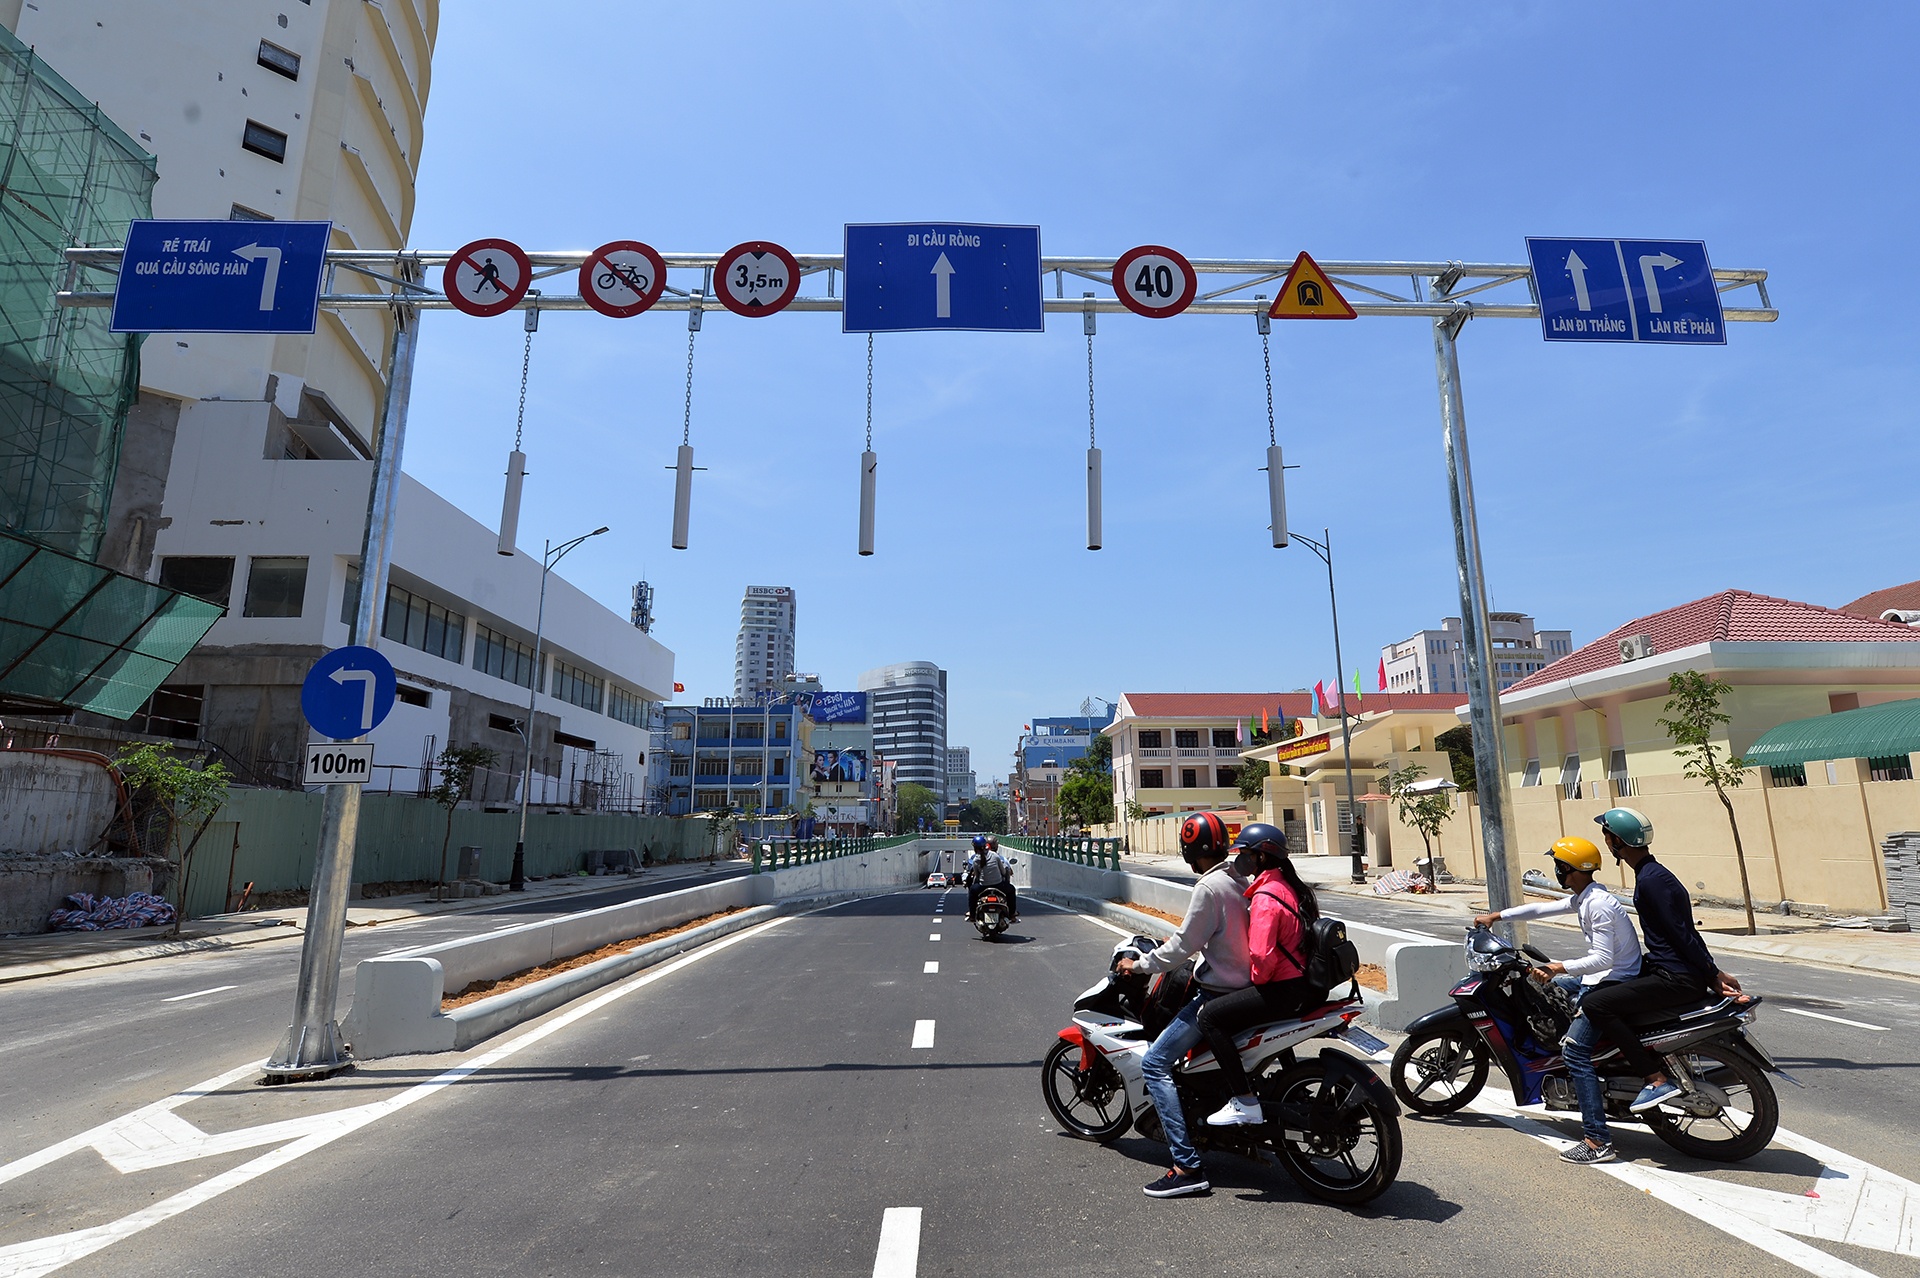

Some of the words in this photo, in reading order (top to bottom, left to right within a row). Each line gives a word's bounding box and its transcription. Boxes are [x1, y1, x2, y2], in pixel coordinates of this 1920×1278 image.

[162, 237, 180, 253] RẼ
[183, 237, 211, 253] TRÁI
[907, 234, 919, 246] ĐI
[922, 228, 946, 246] CẦU
[949, 229, 981, 248] RỒNG
[162, 256, 187, 275] CẦU
[187, 259, 221, 275] SÔNG
[222, 259, 249, 275] HÀN
[735, 264, 783, 294] 3,5m
[1134, 265, 1174, 298] 40
[1552, 315, 1575, 332] LÀN
[1576, 319, 1588, 332] ĐI
[1650, 317, 1672, 334] LÀN
[1673, 318, 1689, 334] RẼ
[1690, 317, 1716, 335] PHẢI
[752, 587, 775, 595] HSBC
[310, 752, 367, 774] 100m
[1184, 822, 1195, 839] 8
